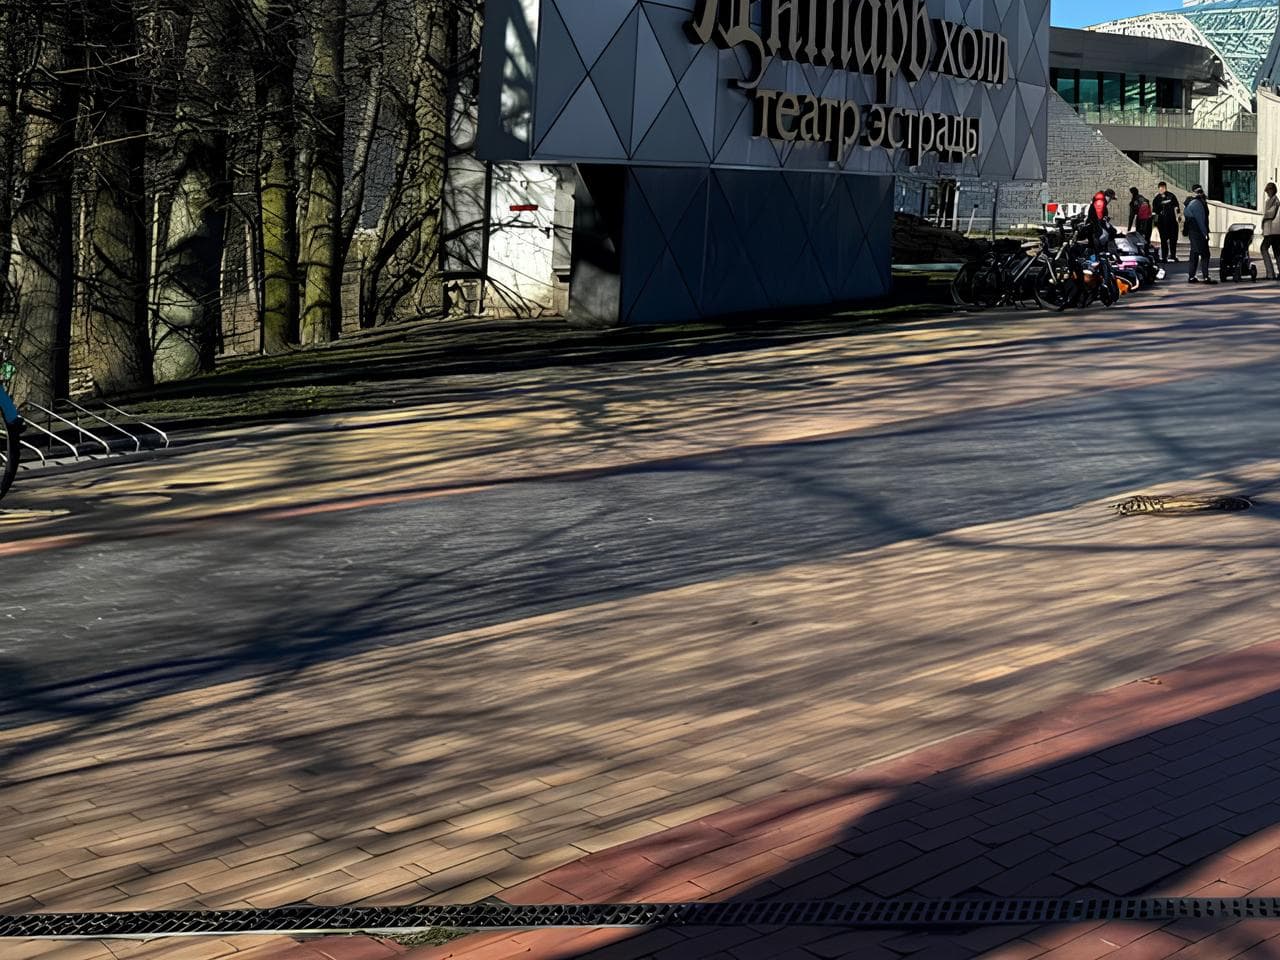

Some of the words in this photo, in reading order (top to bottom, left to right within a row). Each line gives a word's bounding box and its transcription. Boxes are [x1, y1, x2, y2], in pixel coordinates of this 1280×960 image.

[941, 19, 1009, 85] холл
[755, 89, 860, 168] театр
[870, 104, 982, 166] эстрады
